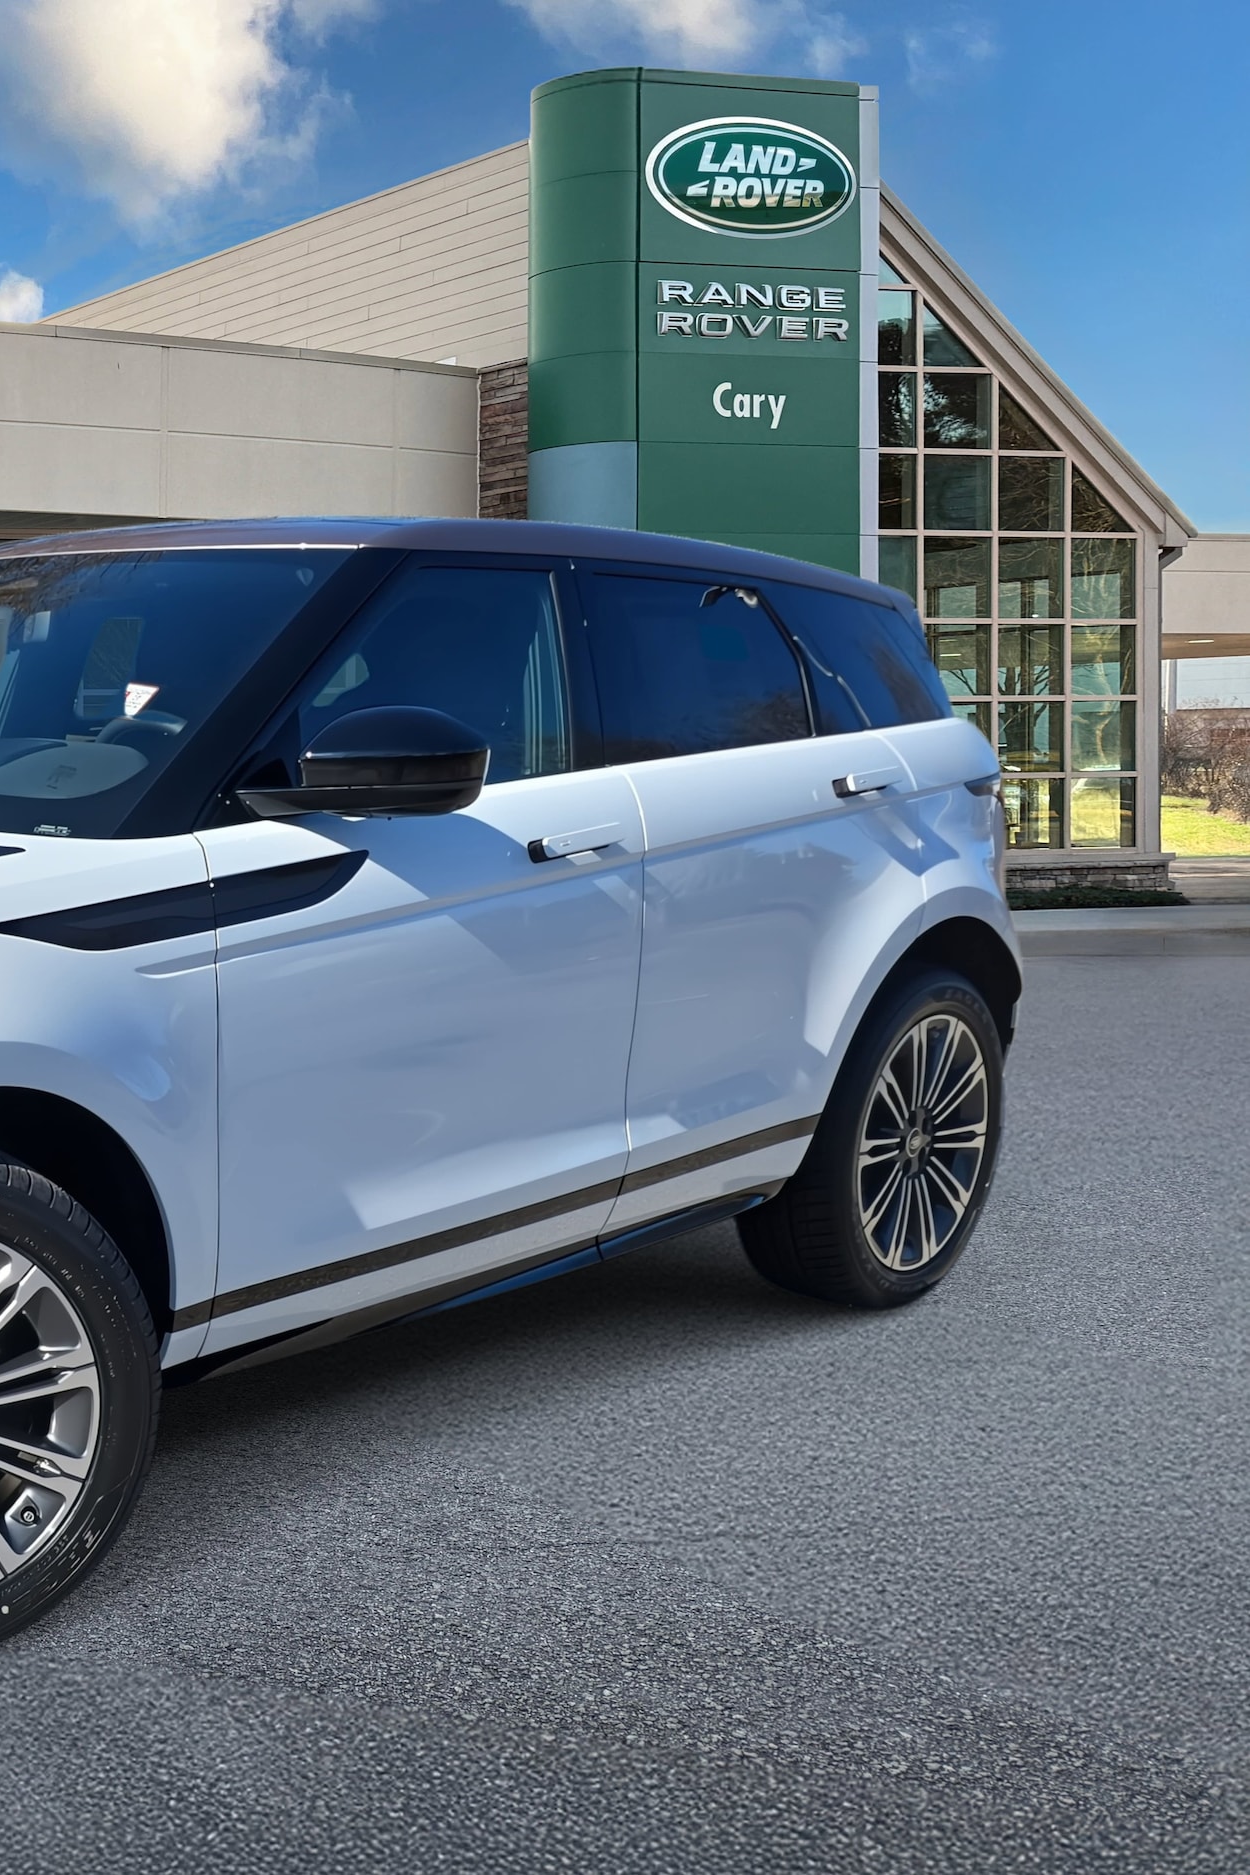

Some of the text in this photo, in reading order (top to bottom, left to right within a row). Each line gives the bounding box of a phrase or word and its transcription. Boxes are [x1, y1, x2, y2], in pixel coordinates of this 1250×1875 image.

[697, 141, 797, 175] LAND
[710, 176, 824, 208] ROVER
[657, 280, 847, 312] RANGE
[657, 311, 850, 342] ROVER
[712, 381, 787, 430] Cary
